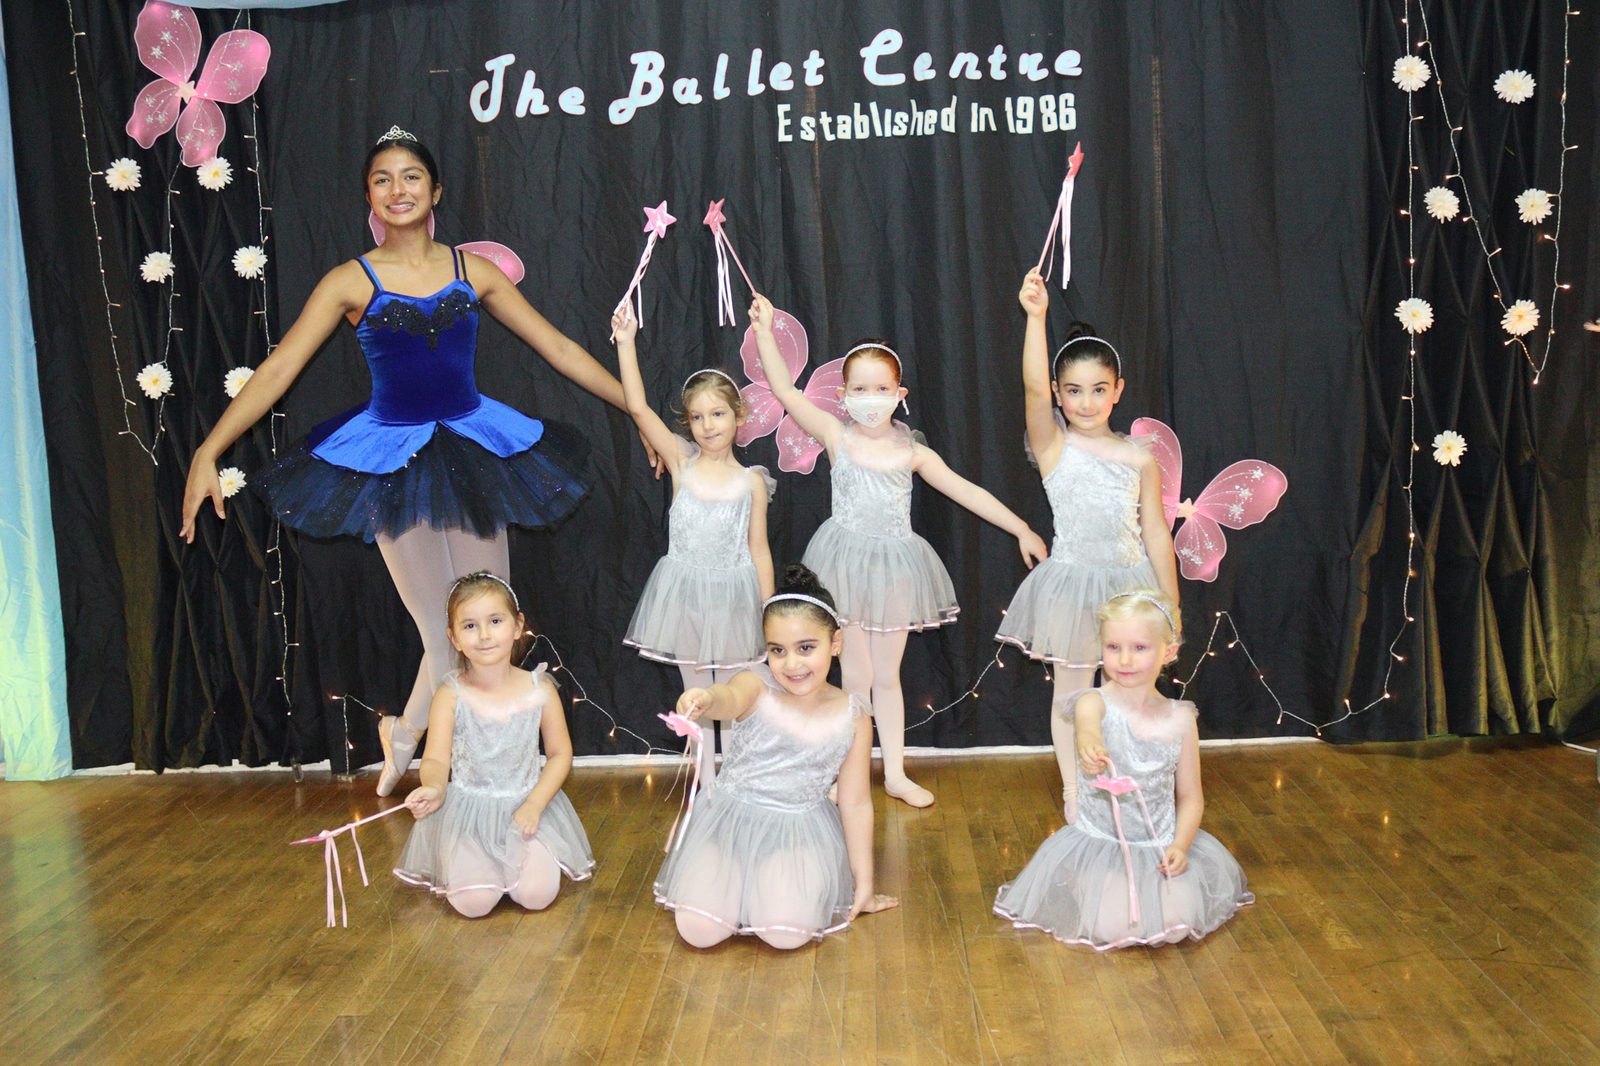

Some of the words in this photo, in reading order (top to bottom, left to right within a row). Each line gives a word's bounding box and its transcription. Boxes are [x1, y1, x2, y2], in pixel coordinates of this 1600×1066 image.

[469, 53, 586, 123] The
[608, 48, 825, 125] Ballet
[859, 28, 1083, 87] Centre
[777, 94, 958, 142] Established
[1004, 92, 1077, 135] 1986
